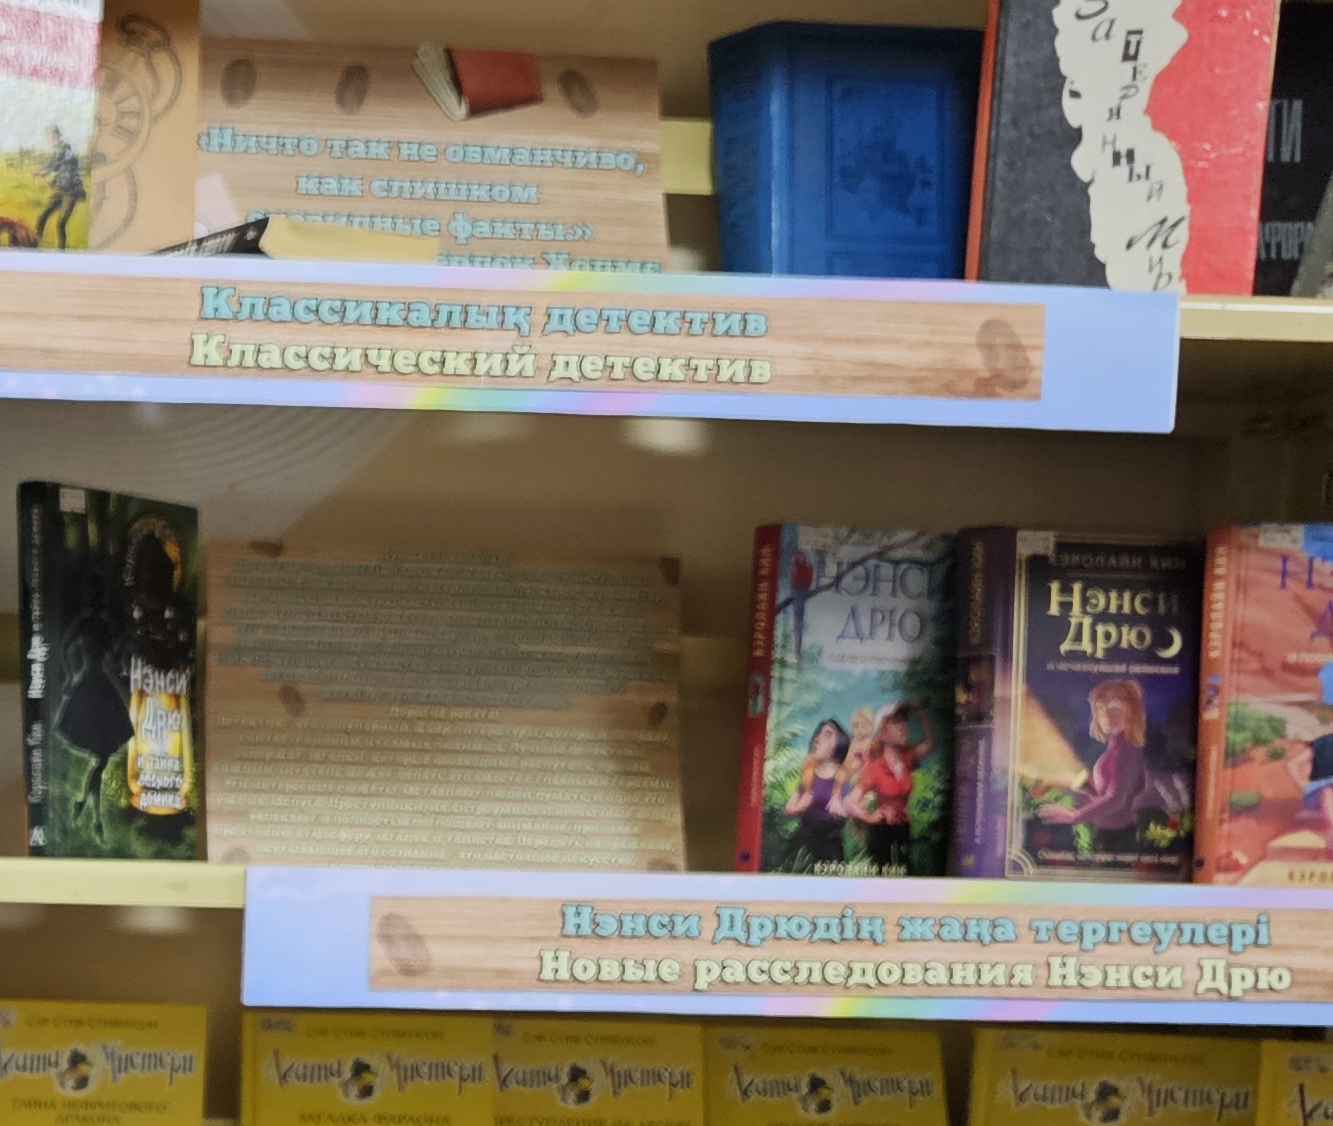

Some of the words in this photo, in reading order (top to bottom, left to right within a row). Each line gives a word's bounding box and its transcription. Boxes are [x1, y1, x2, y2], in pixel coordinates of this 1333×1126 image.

[197, 125, 320, 158] «Ничто
[325, 136, 391, 162] так
[398, 139, 438, 163] не
[445, 142, 648, 177] обманчиво,
[296, 172, 365, 197] как
[370, 177, 540, 204] слишком
[448, 210, 593, 245] факты.»
[200, 285, 532, 336] Классикалық
[542, 304, 769, 338] детектив
[190, 332, 536, 378] Классический
[549, 349, 773, 385] детектив
[1046, 579, 1180, 617] Нэнси
[835, 604, 925, 644] ДРЮ
[1059, 615, 1154, 659] Дрю
[130, 655, 189, 696] Нэнси
[562, 903, 701, 940] Нэнси
[897, 914, 1017, 949] жаңа
[1029, 912, 1273, 955] тергеулері
[539, 948, 681, 984] Новые
[694, 954, 1034, 994] расследования
[1047, 956, 1184, 991] Нэнси
[1194, 957, 1293, 998] Дрю
